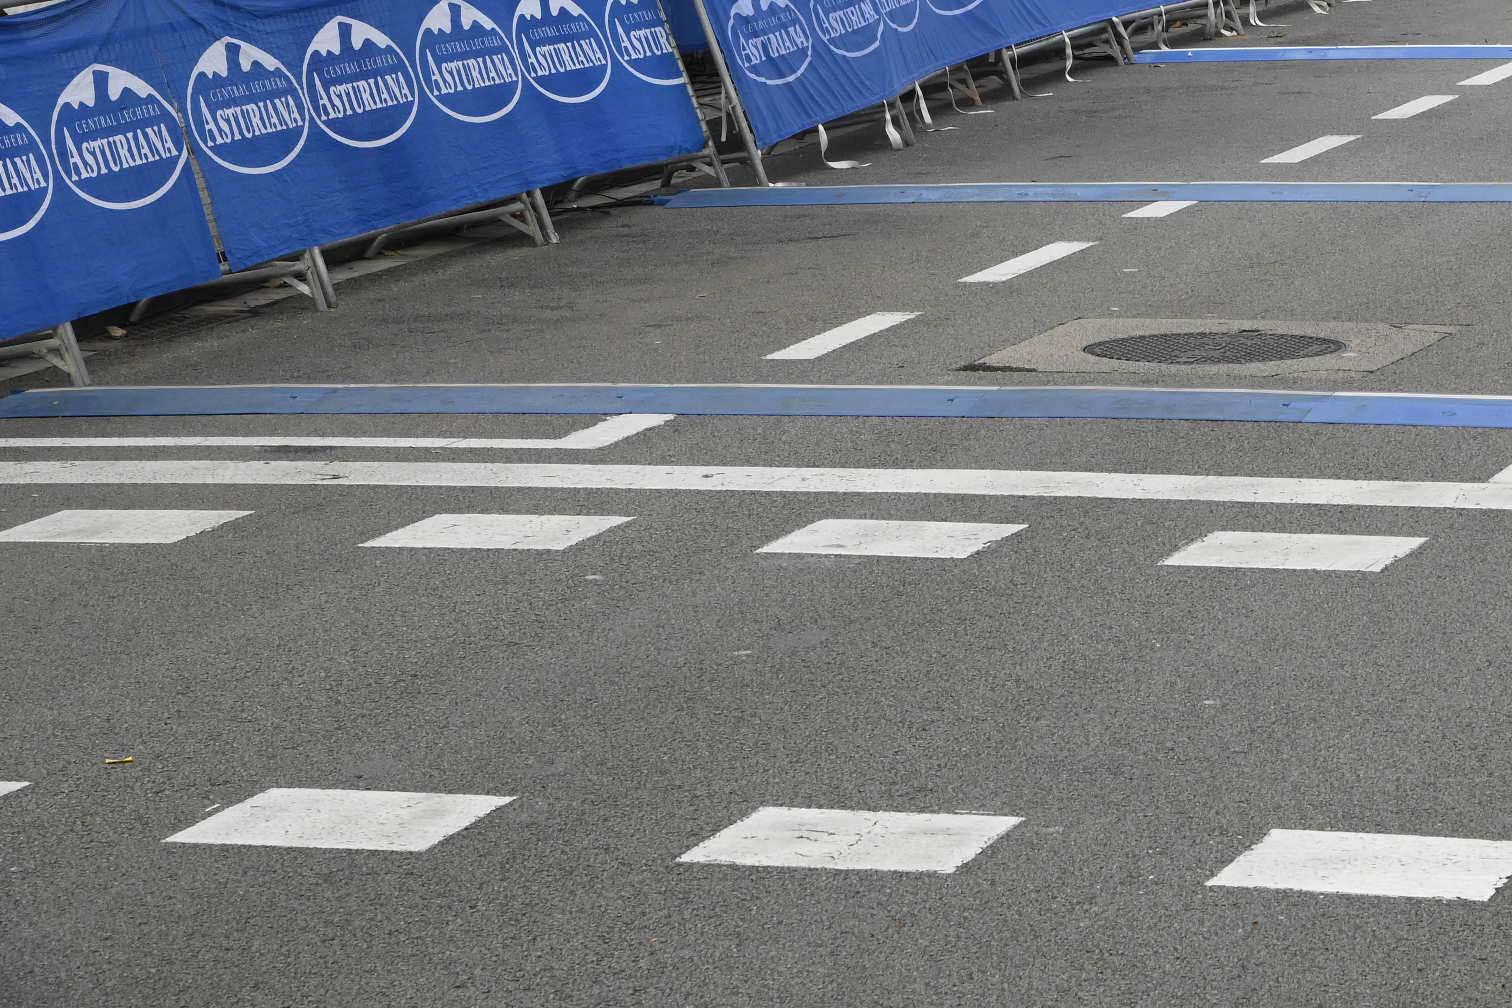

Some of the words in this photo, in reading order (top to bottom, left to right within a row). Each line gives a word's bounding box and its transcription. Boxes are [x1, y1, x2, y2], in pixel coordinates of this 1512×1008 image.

[529, 24, 558, 40] CENTRAL
[559, 20, 589, 35] LECHERA
[624, 11, 655, 26] CENTRAL
[435, 40, 470, 56] CENTRAL
[471, 35, 502, 50] LECHERA
[615, 16, 674, 61] ASTUR
[324, 63, 359, 79] CENTRAL
[361, 54, 398, 73] LECHERA
[522, 32, 606, 78] ASTURIANA
[426, 48, 517, 96] ASTURIANA
[210, 83, 249, 103] CENTRAL
[250, 77, 287, 94] LECHERA
[313, 71, 413, 122] ASTURIANA
[75, 113, 116, 133] CENTRAL
[120, 103, 160, 124] LECHERA
[200, 94, 303, 147] ASTURIANA
[0, 132, 28, 147] CHERA
[63, 122, 179, 181] ASTURIANA
